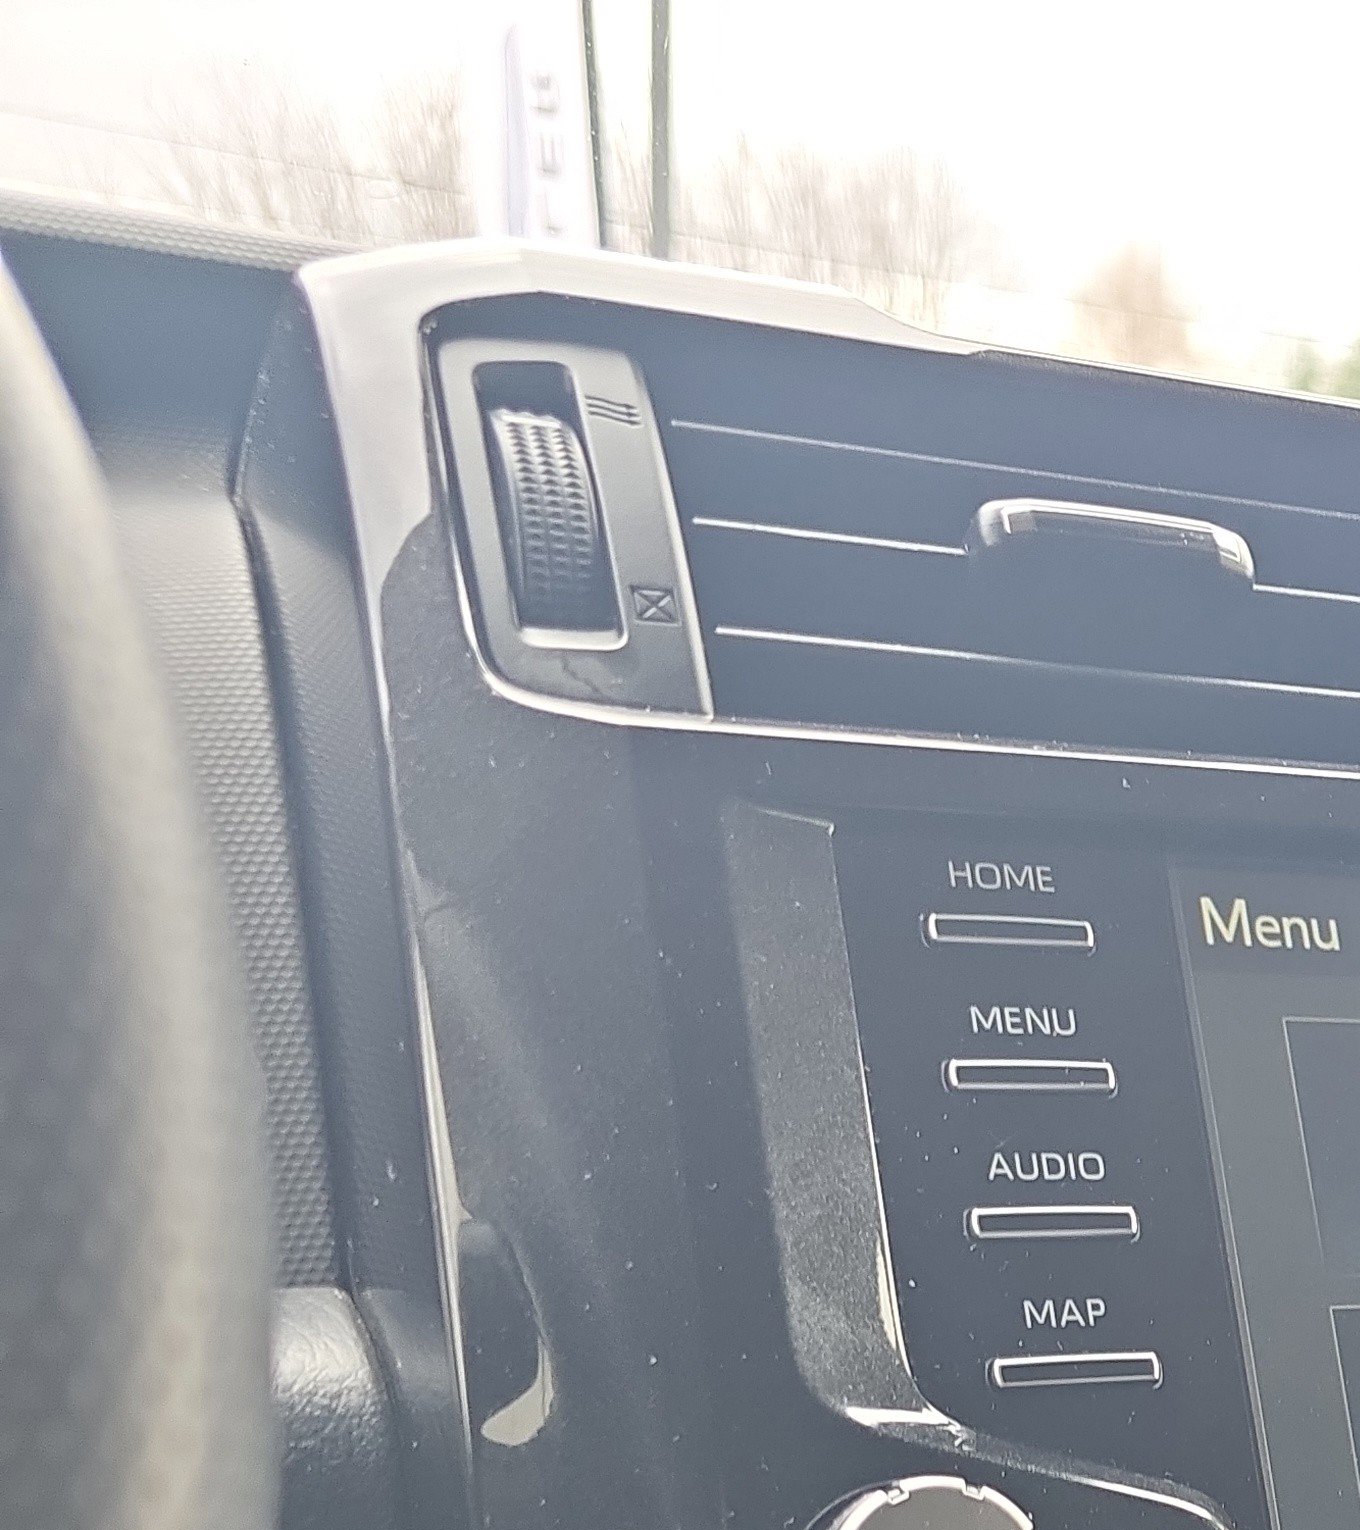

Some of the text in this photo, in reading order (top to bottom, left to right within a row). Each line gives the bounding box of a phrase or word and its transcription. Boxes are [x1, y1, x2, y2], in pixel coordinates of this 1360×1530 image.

[948, 860, 1056, 894] HOME
[1200, 897, 1341, 951] Menu
[970, 1006, 1077, 1036] MENU
[988, 1152, 1106, 1181] AUDIO
[1023, 1299, 1106, 1328] MAP
